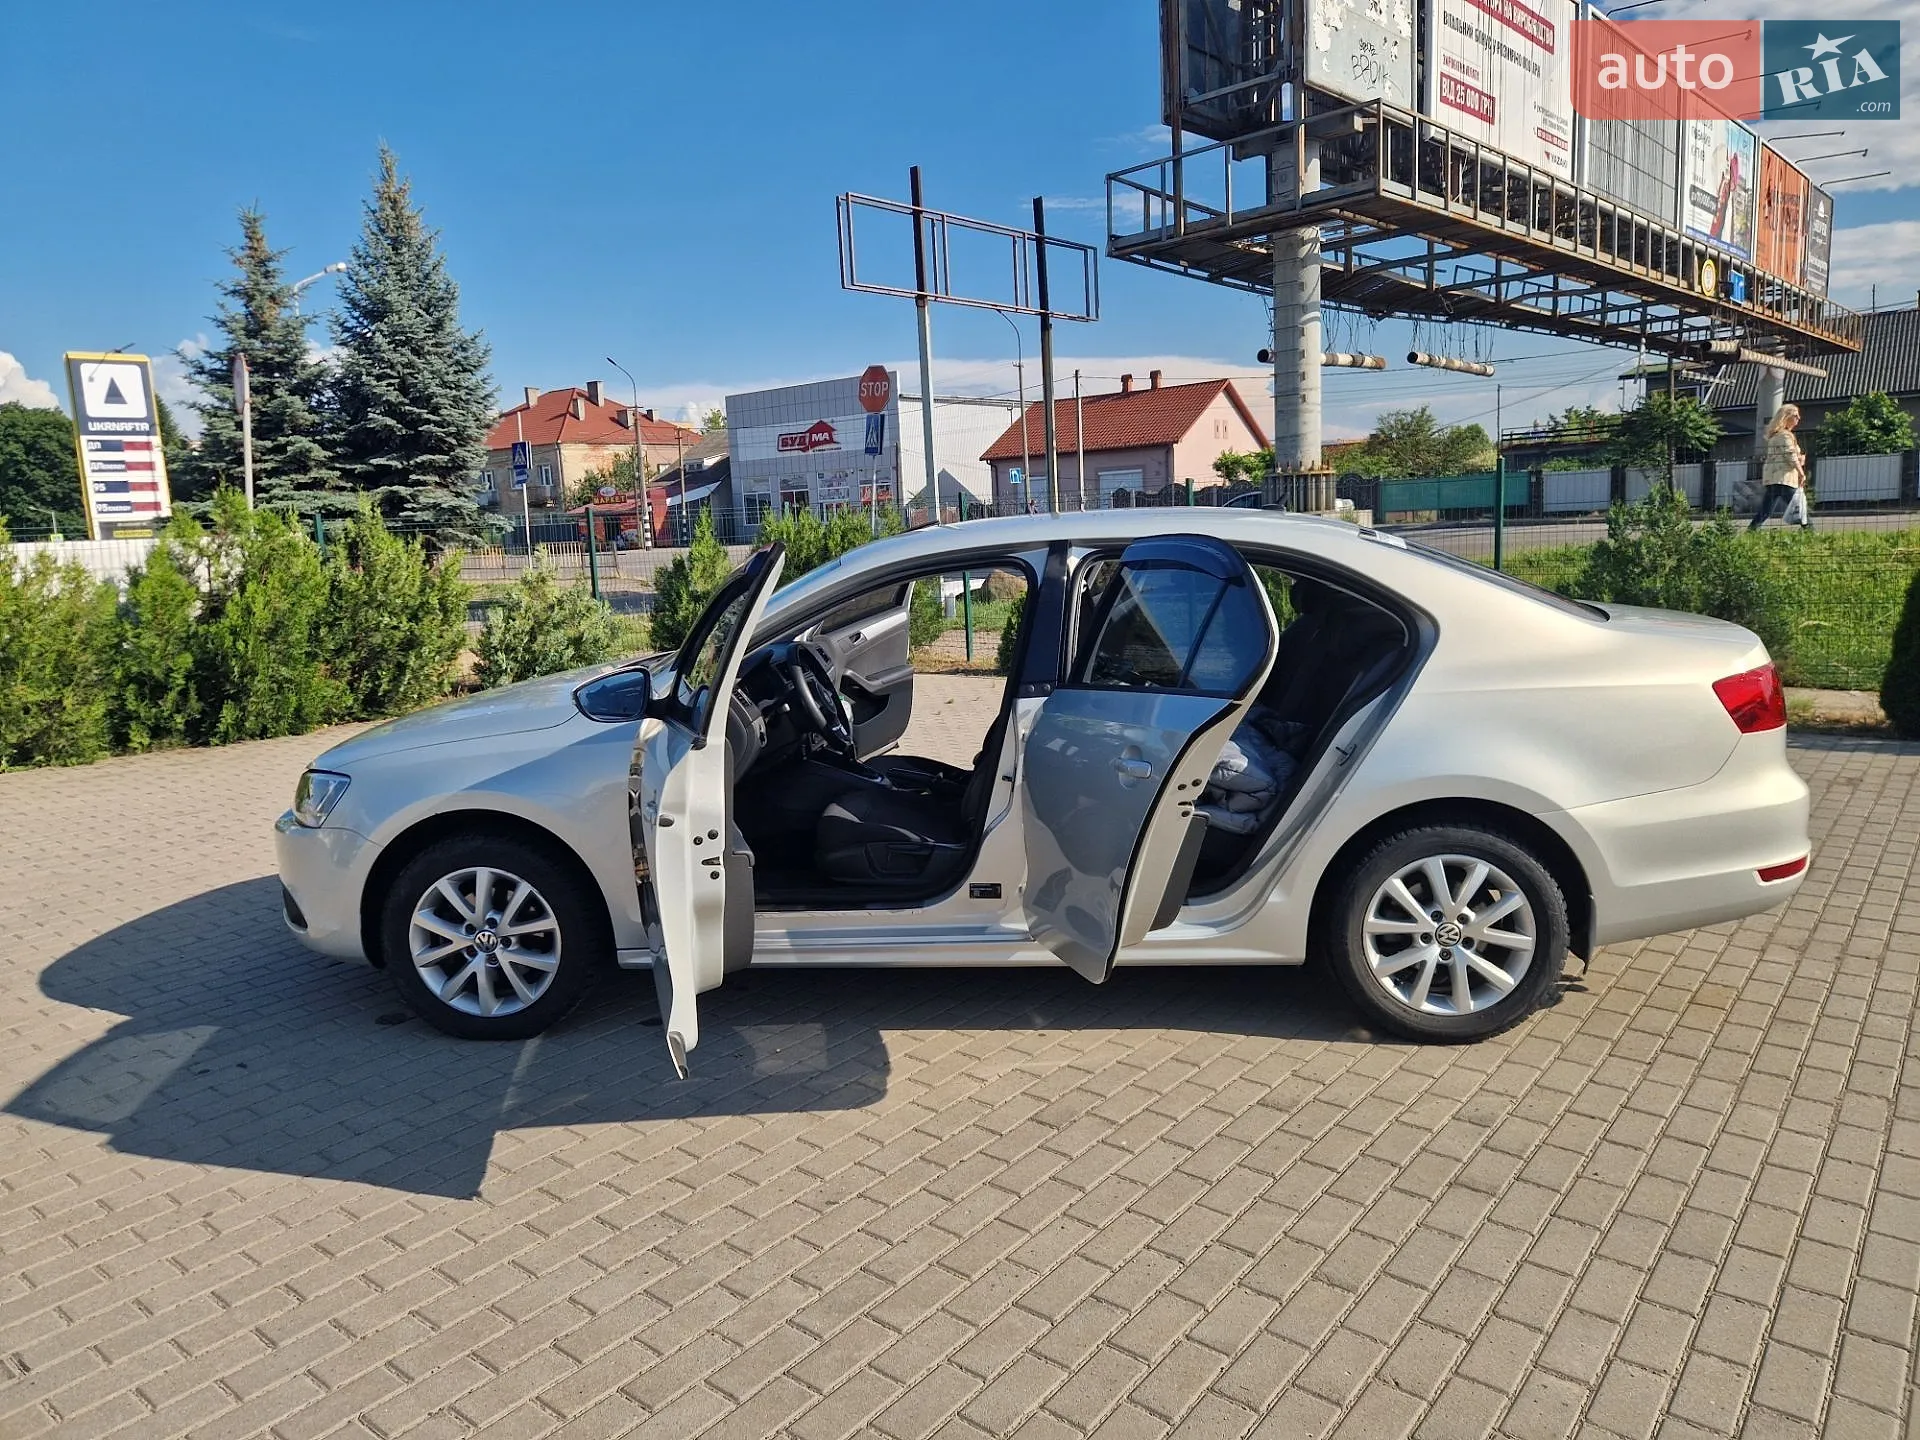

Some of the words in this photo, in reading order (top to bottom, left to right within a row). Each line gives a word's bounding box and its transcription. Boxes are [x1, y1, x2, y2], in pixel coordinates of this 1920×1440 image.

[1441, 77, 1455, 104] ВІД
[1456, 84, 1465, 105] 25
[1466, 88, 1479, 111] 000
[1480, 95, 1493, 118] ГРН
[860, 381, 889, 397] STOP
[87, 421, 150, 431] UKRNAFTA
[93, 483, 106, 492] 95
[593, 495, 627, 505] МАРКЕТ
